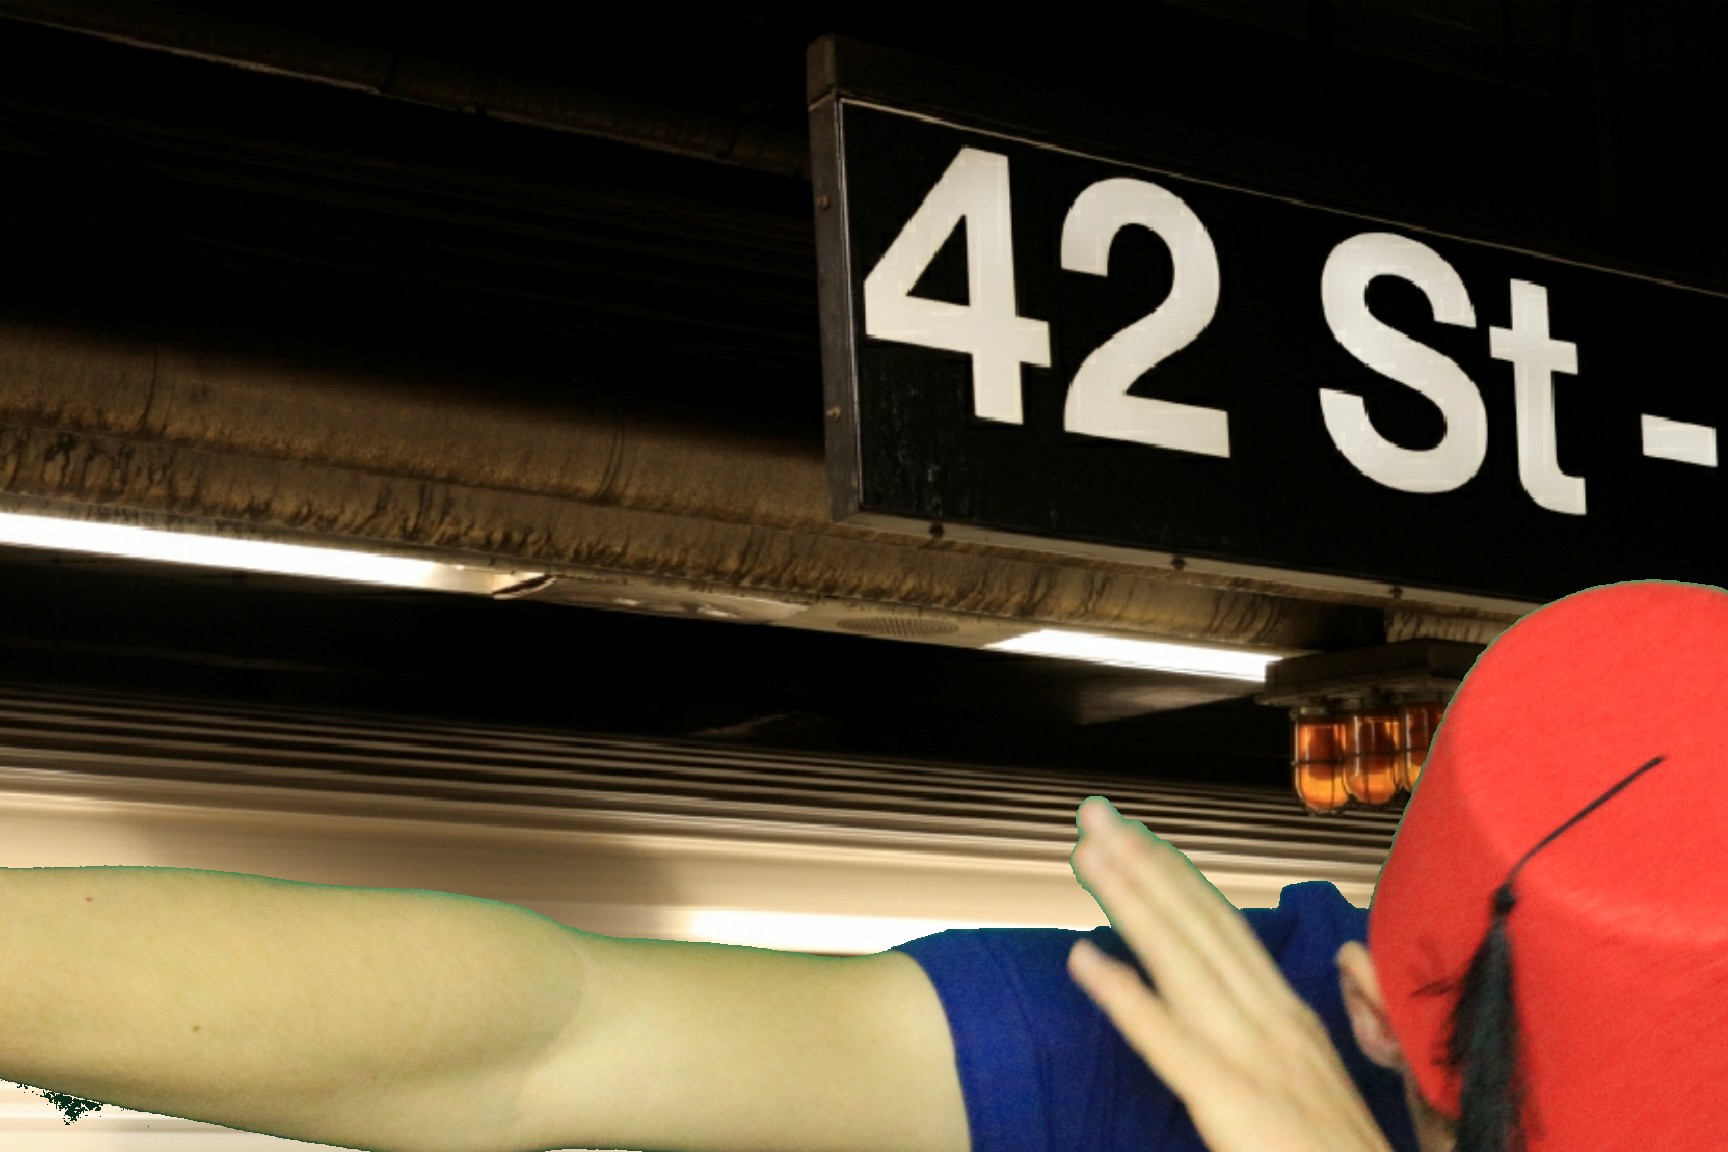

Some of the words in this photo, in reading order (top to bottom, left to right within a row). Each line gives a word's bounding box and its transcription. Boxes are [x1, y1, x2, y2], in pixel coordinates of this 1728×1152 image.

[864, 148, 1229, 458] 42
[1319, 232, 1587, 515] St
[1641, 414, 1718, 467] -
